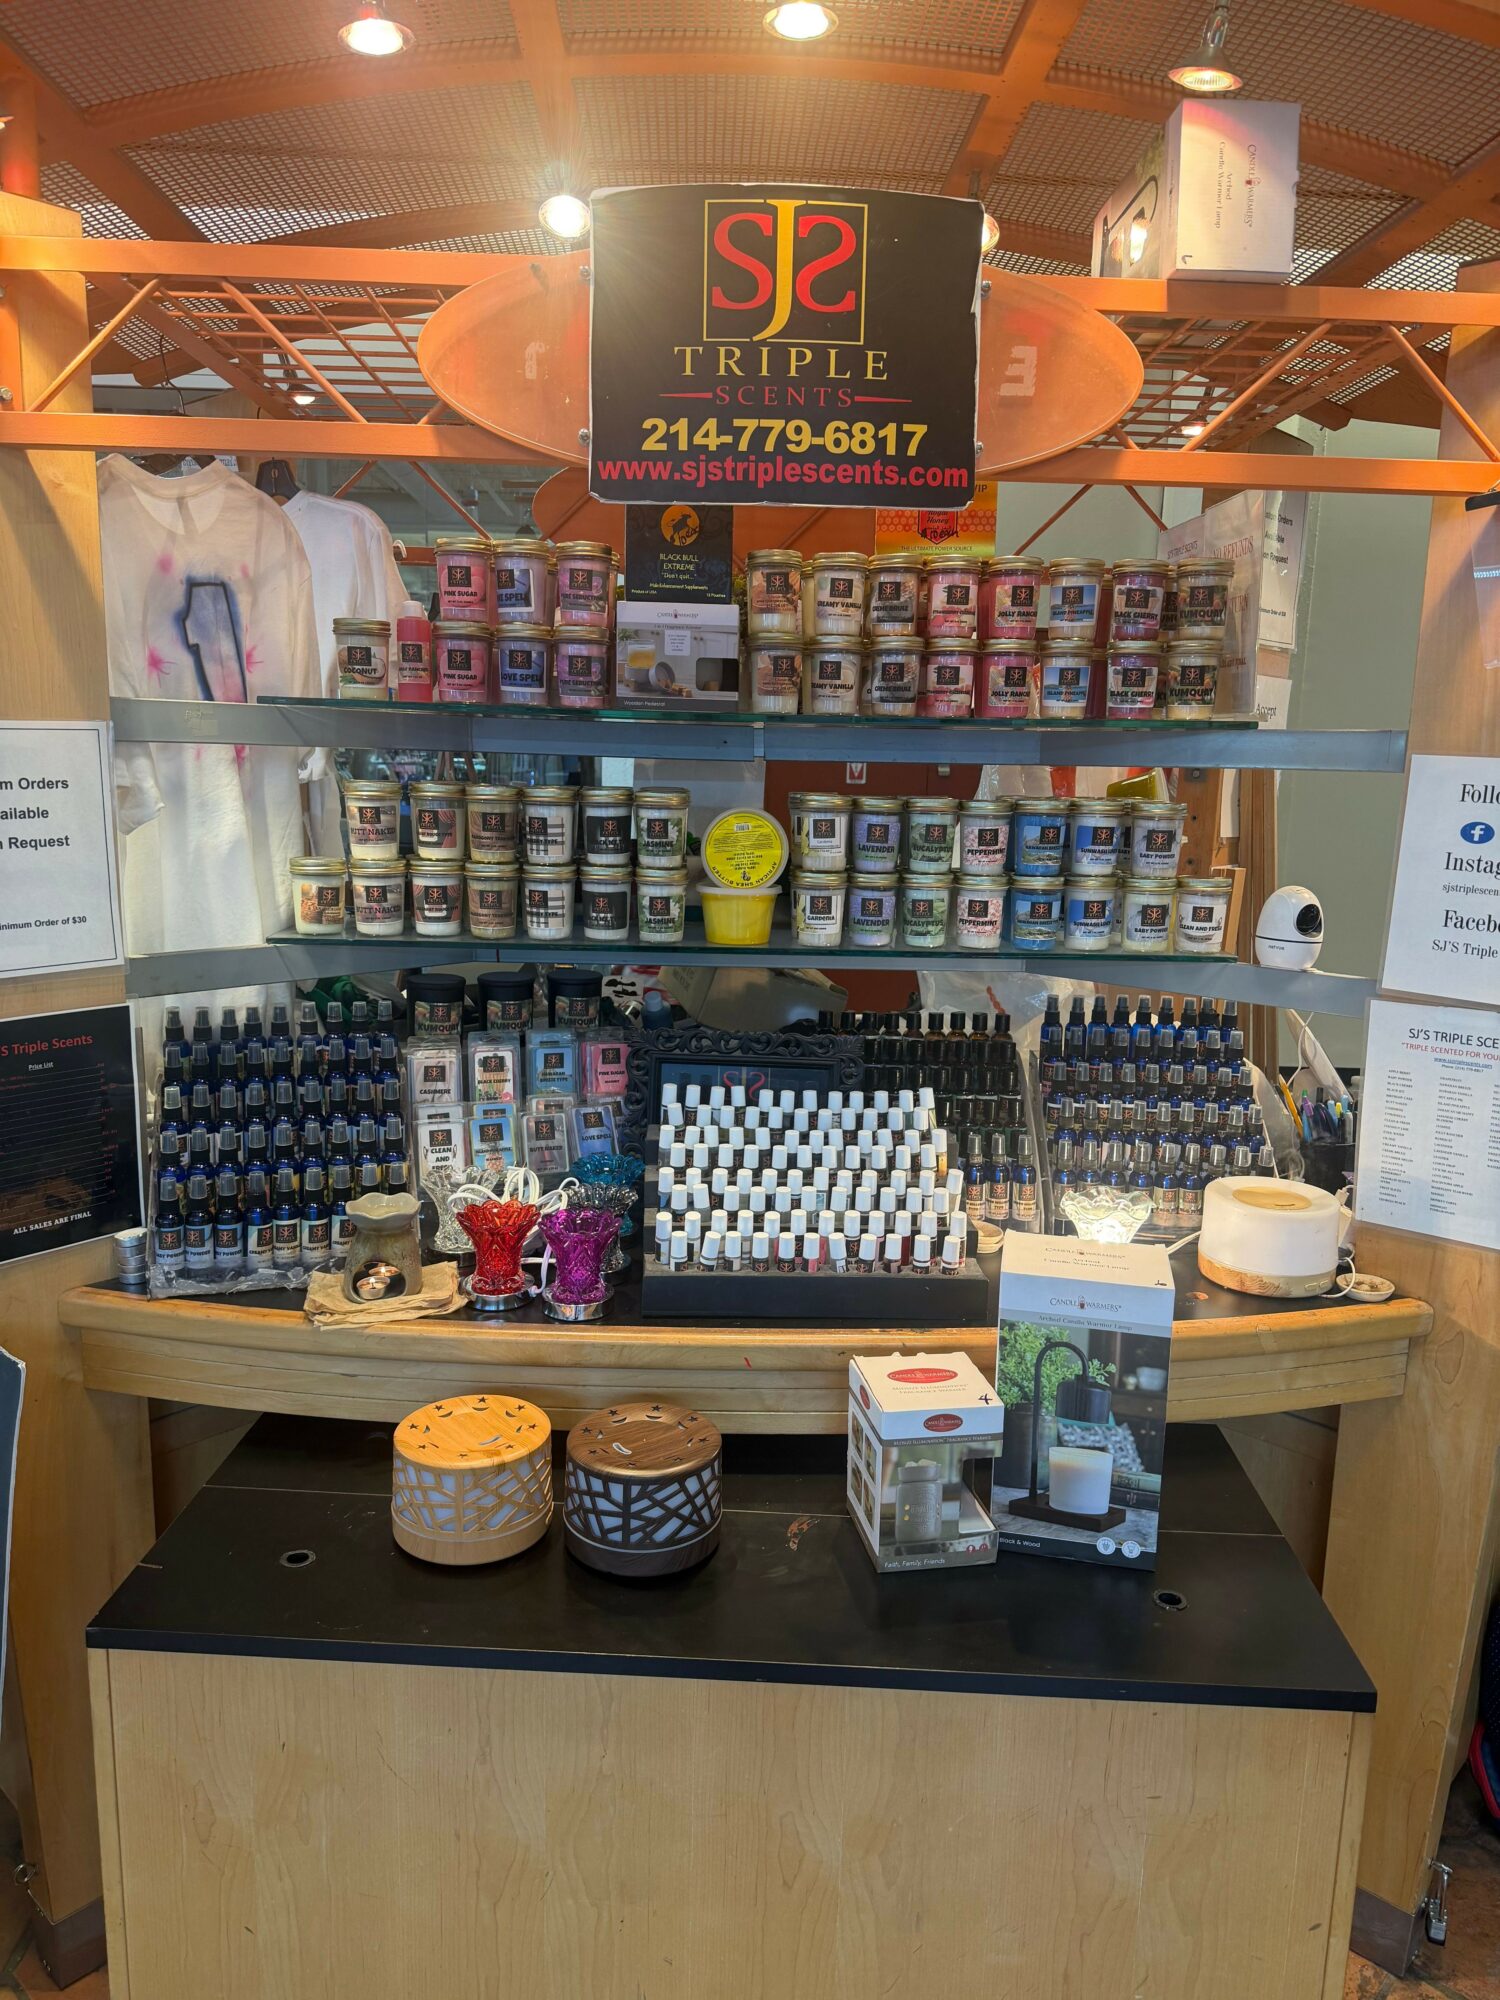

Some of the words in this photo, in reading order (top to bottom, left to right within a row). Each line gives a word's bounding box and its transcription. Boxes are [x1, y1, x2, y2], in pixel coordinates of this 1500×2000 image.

[674, 345, 888, 381] TRIPLE
[715, 384, 853, 408] SCENTS
[641, 417, 929, 457] 214-779-6817
[597, 455, 969, 489] www.sjstriplescents.com
[1222, 535, 1255, 561] REFUNDS
[659, 553, 681, 561] BLACK
[682, 554, 699, 562] BULL
[663, 563, 695, 571] EXTREME
[998, 610, 1017, 618] JOLLY
[1132, 611, 1158, 621] CHERRY
[343, 666, 378, 675] COCONUT
[991, 690, 1010, 698] JOLLY
[1255, 703, 1277, 717] Accept
[18, 778, 69, 790] Orders
[8, 835, 70, 850] Request
[858, 844, 895, 853] LAVENDER
[711, 865, 734, 885] BUTTER
[756, 861, 777, 884] AFRICAN
[34, 919, 59, 928] Order
[61, 917, 70, 925] of
[72, 915, 87, 925] $30
[853, 918, 890, 926] LAVENDER
[958, 918, 997, 926] PEPPERMINT
[1432, 939, 1460, 953] SJ'S
[1462, 943, 1498, 960] Triple
[1408, 1028, 1431, 1041] SJ'S
[1433, 1030, 1474, 1046] TRIPLE
[12, 1040, 49, 1056] Triple
[52, 1034, 94, 1050] Scents
[1430, 1046, 1465, 1056] SCENTED
[1465, 1050, 1482, 1058] FOR
[28, 1062, 42, 1071] Price
[42, 1061, 54, 1070] List
[419, 1087, 452, 1095] CASHMERE
[581, 1134, 595, 1142] LOVE
[430, 1146, 452, 1154] CLEAN
[13, 1226, 28, 1235] ALL
[29, 1221, 53, 1231] SALES
[54, 1217, 69, 1226] ARE
[70, 1211, 92, 1222] FINAL
[1049, 1297, 1079, 1307] CANDLE
[1114, 1323, 1133, 1331] Lamp
[1022, 1540, 1041, 1548] Wood
[923, 1557, 946, 1566] Friends
